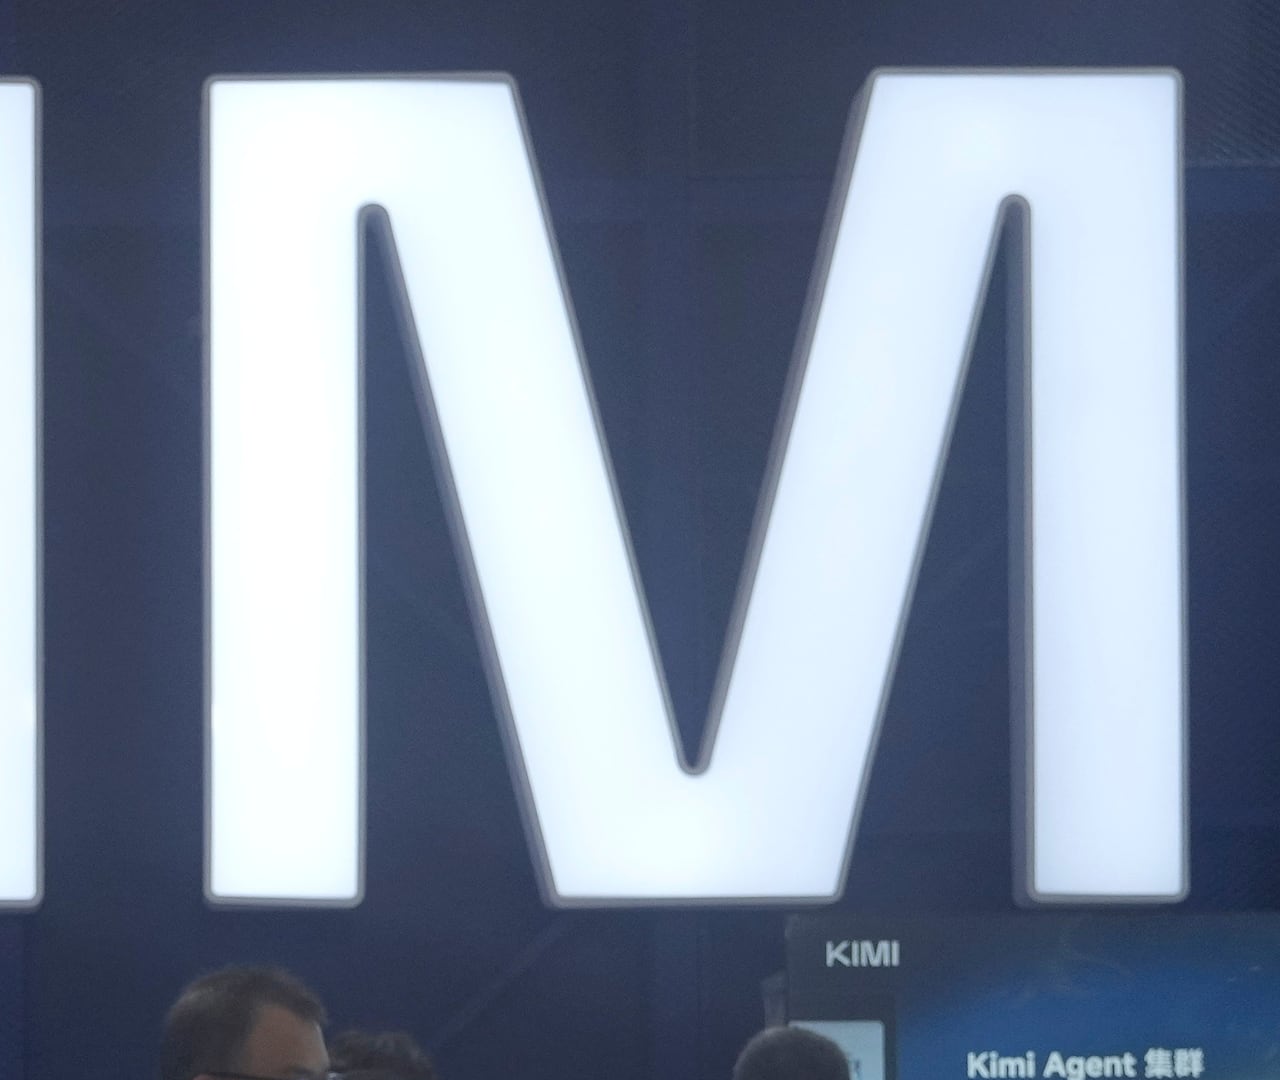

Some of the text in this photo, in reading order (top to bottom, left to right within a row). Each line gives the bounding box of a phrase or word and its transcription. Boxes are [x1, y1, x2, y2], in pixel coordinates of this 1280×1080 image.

[825, 940, 900, 967] KIMI
[967, 1051, 1036, 1079] Kimi
[1144, 1048, 1205, 1079] 集群
